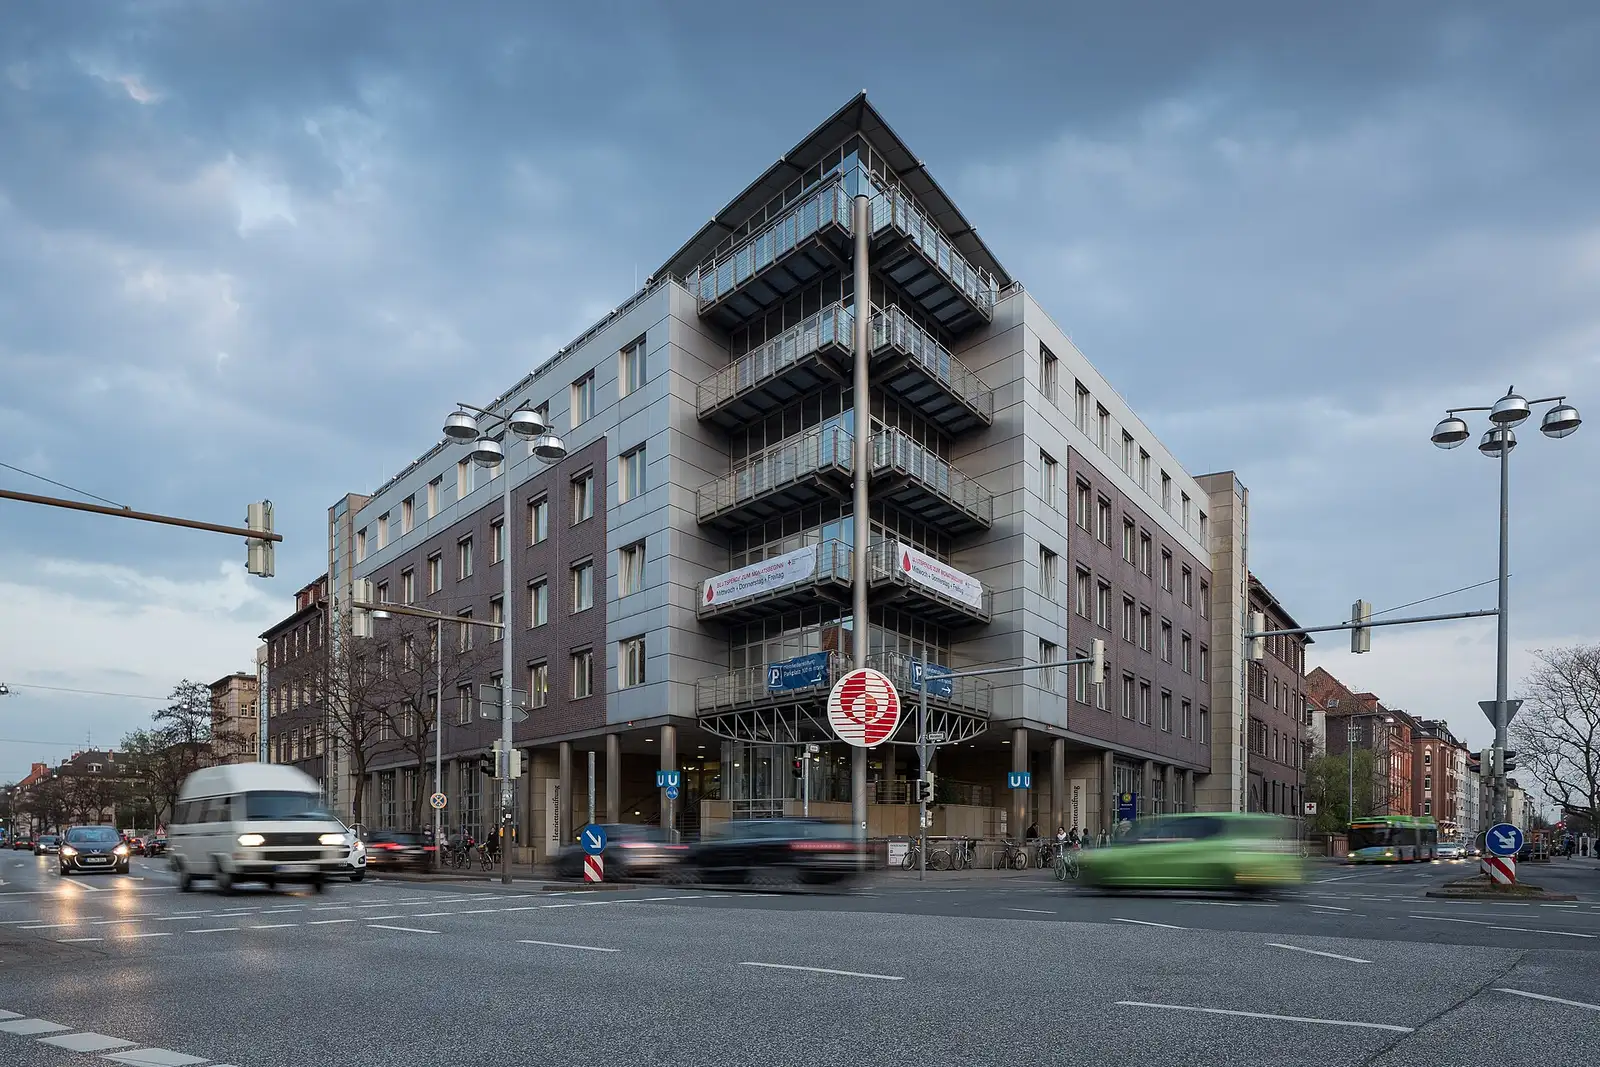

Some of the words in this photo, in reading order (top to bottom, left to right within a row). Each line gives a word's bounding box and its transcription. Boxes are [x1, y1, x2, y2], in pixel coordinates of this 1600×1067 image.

[912, 564, 928, 577] Mittwoch
[931, 573, 950, 589] Donnerstag
[716, 585, 737, 596] Mittwoch
[738, 577, 764, 590] Donnerstag
[767, 572, 785, 582] Freitag
[771, 669, 780, 684] P
[658, 774, 664, 786] U
[668, 774, 678, 786] U
[1011, 776, 1021, 787] U
